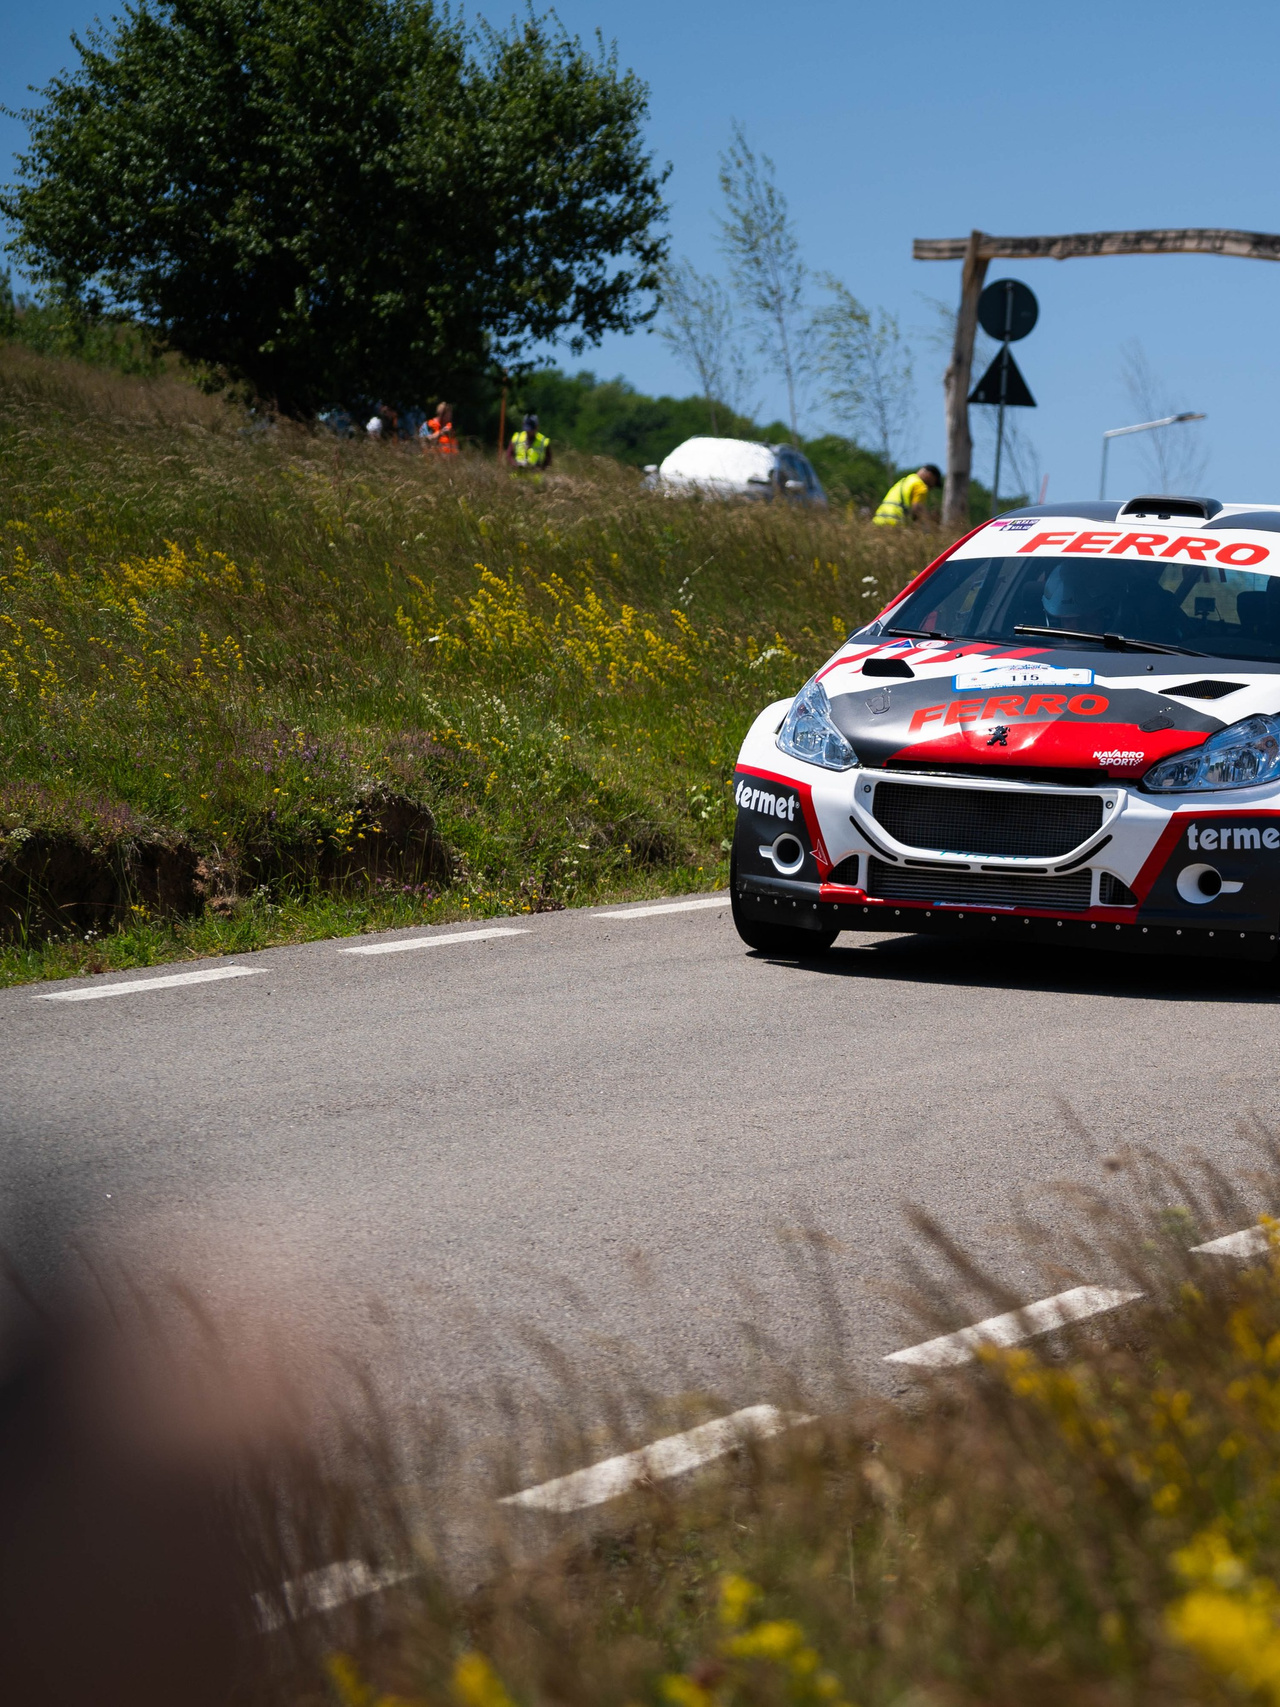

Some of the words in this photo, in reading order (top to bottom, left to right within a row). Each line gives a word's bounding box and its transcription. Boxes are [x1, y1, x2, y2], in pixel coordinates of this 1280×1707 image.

[1016, 531, 1270, 566] FERRO
[1012, 674, 1039, 682] 115
[907, 693, 1110, 736] FERRO
[1092, 749, 1145, 759] NAVARRO
[1099, 758, 1136, 766] SPORT
[735, 779, 796, 822] termet
